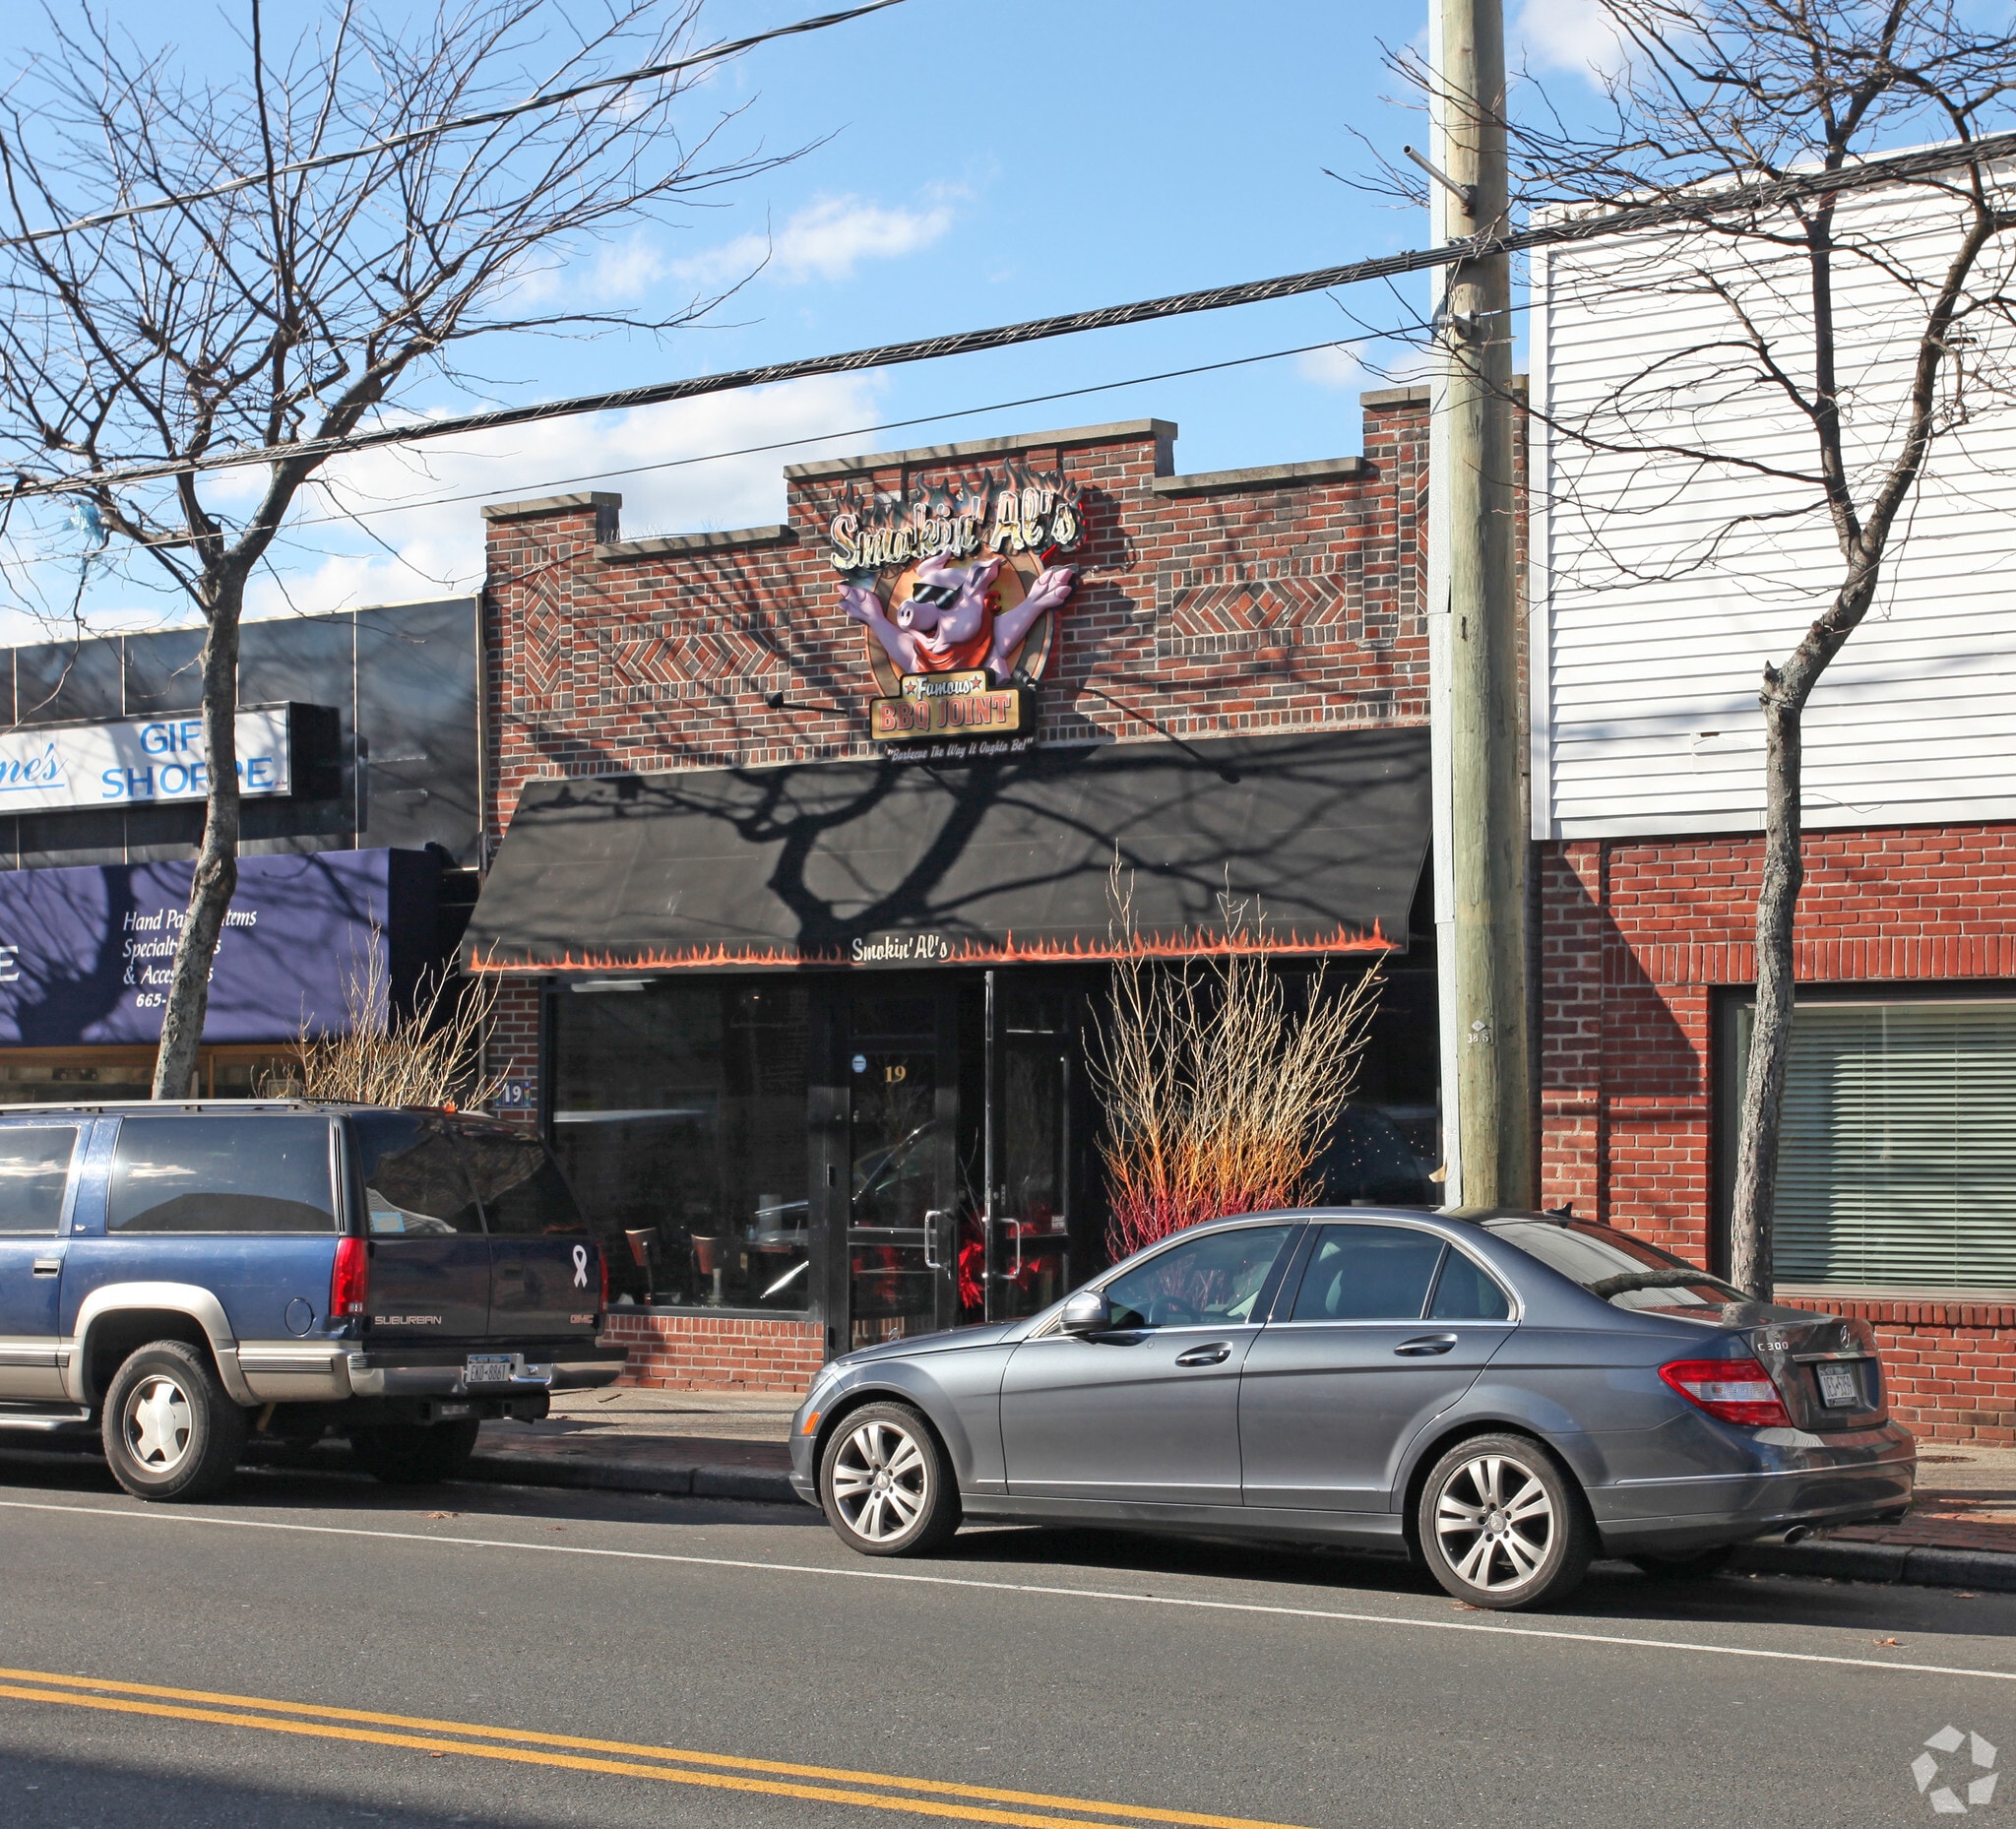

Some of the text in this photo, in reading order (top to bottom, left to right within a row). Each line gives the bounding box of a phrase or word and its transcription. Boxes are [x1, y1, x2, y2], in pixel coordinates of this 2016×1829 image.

[916, 677, 971, 700] Famous
[879, 695, 1010, 731] BBQ JOINT
[141, 721, 203, 754] GIF
[931, 745, 945, 758] The
[947, 744, 966, 759] Way
[123, 909, 163, 931] Hand
[221, 910, 257, 927] tems
[852, 934, 948, 962] Smokin' Al's
[123, 965, 136, 984] &
[884, 1065, 907, 1083] 19
[505, 1085, 522, 1103] 19
[374, 1315, 442, 1325] SUBURBAN
[569, 1314, 594, 1324] GMC
[1757, 1341, 1789, 1352] C 300
